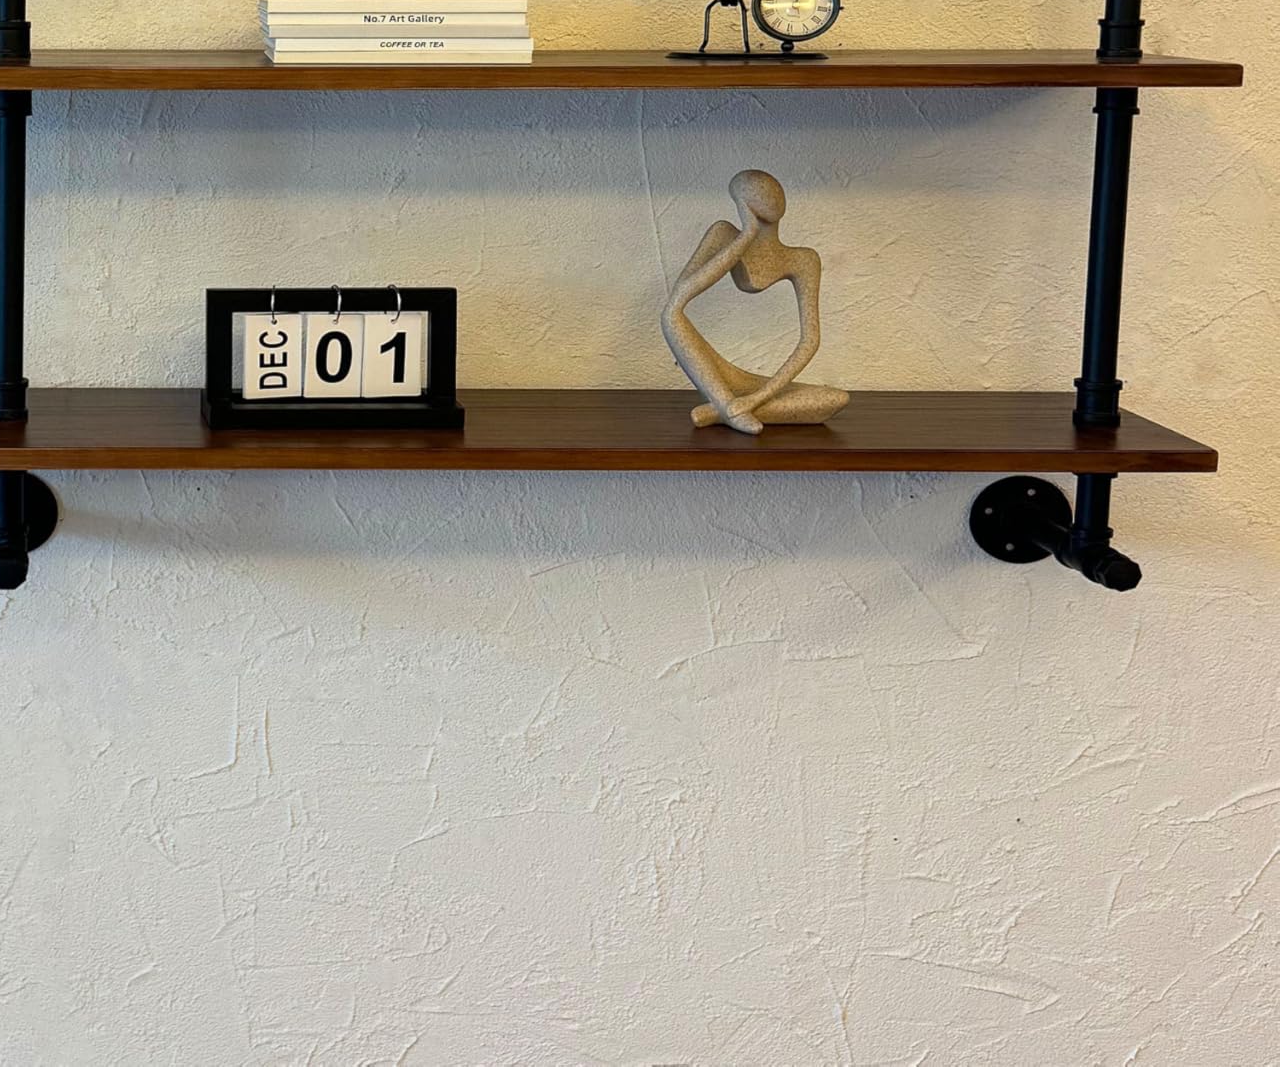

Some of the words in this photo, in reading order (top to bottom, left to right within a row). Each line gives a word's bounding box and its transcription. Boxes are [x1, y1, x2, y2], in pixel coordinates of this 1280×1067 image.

[363, 15, 386, 23] No.7
[389, 15, 405, 23] Art
[407, 14, 445, 24] Gallery
[259, 330, 288, 390] DEC
